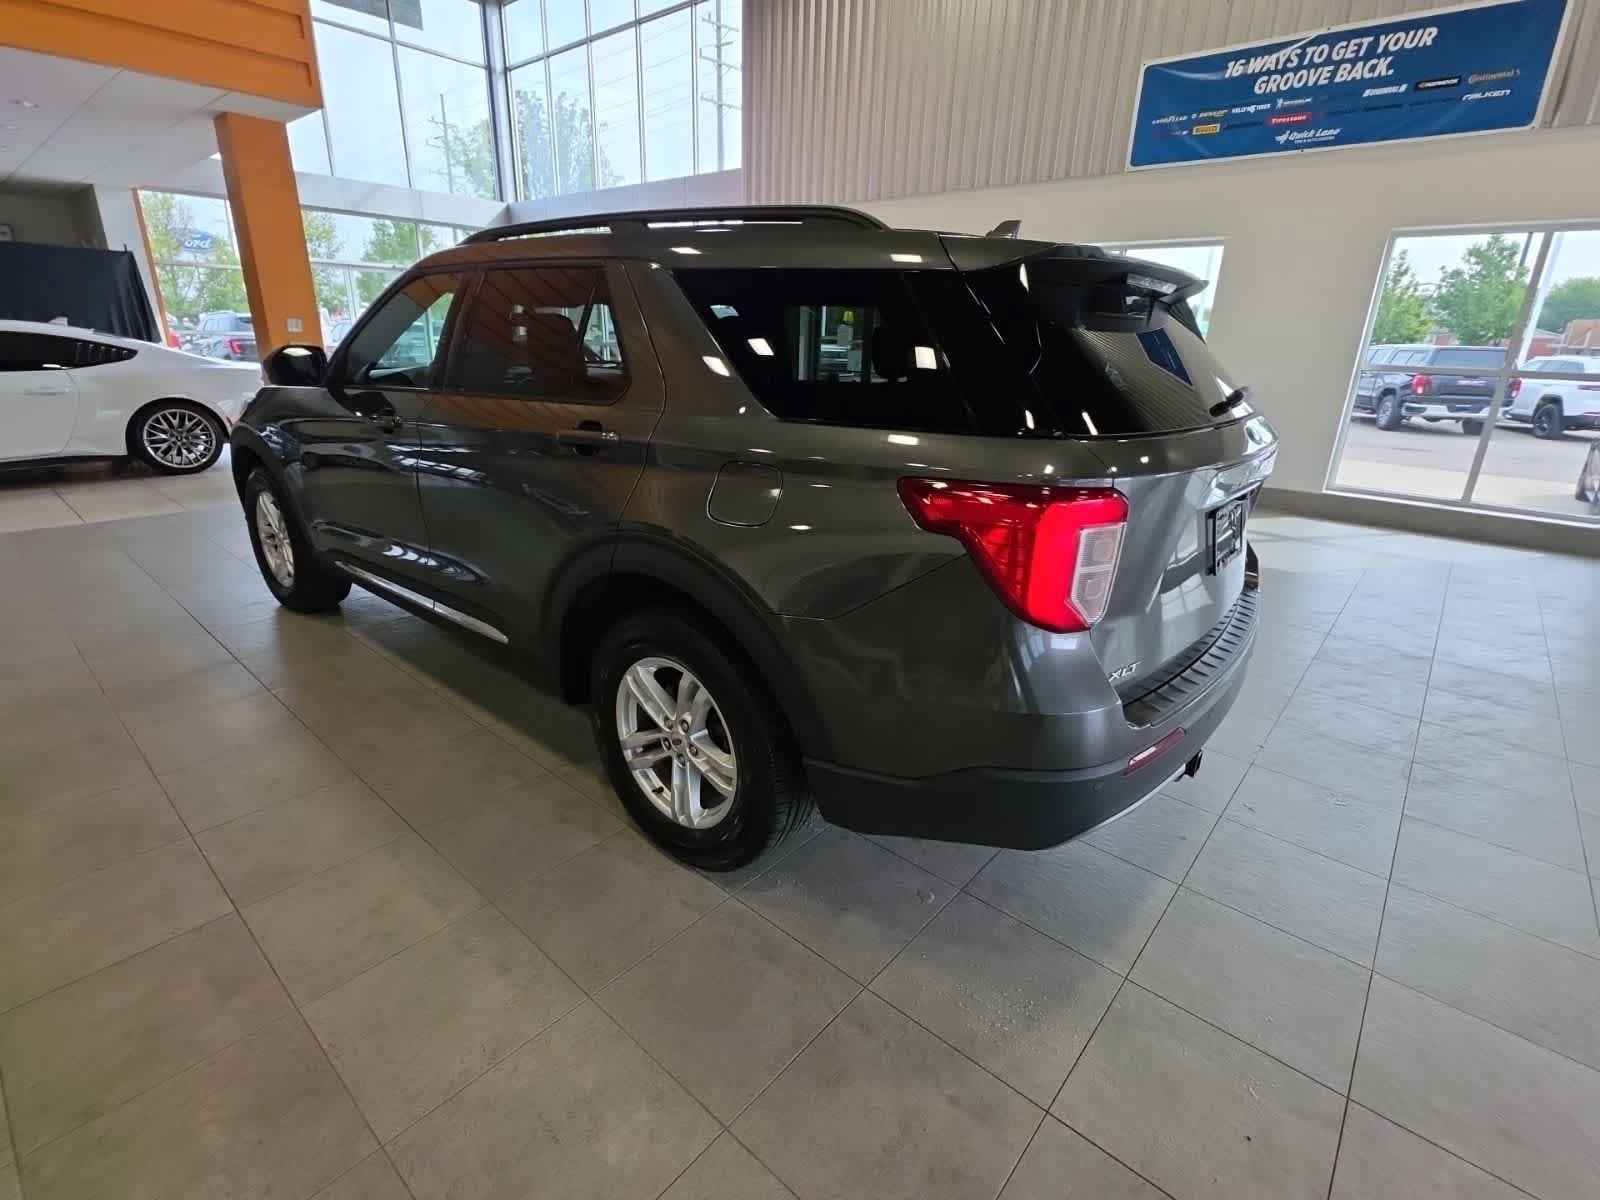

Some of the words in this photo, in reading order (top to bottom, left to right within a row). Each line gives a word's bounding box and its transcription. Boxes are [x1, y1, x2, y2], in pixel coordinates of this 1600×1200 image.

[1224, 60, 1246, 79] 16
[1247, 46, 1302, 75] WAYS
[1302, 43, 1331, 65] TO
[1332, 36, 1375, 61] GET
[1376, 26, 1438, 54] YOUR
[1253, 66, 1334, 95] GROOVE
[1334, 56, 1395, 84] BACK.
[1288, 129, 1315, 140] Quick
[1315, 126, 1343, 138] Lane
[1108, 661, 1142, 682] XLT
